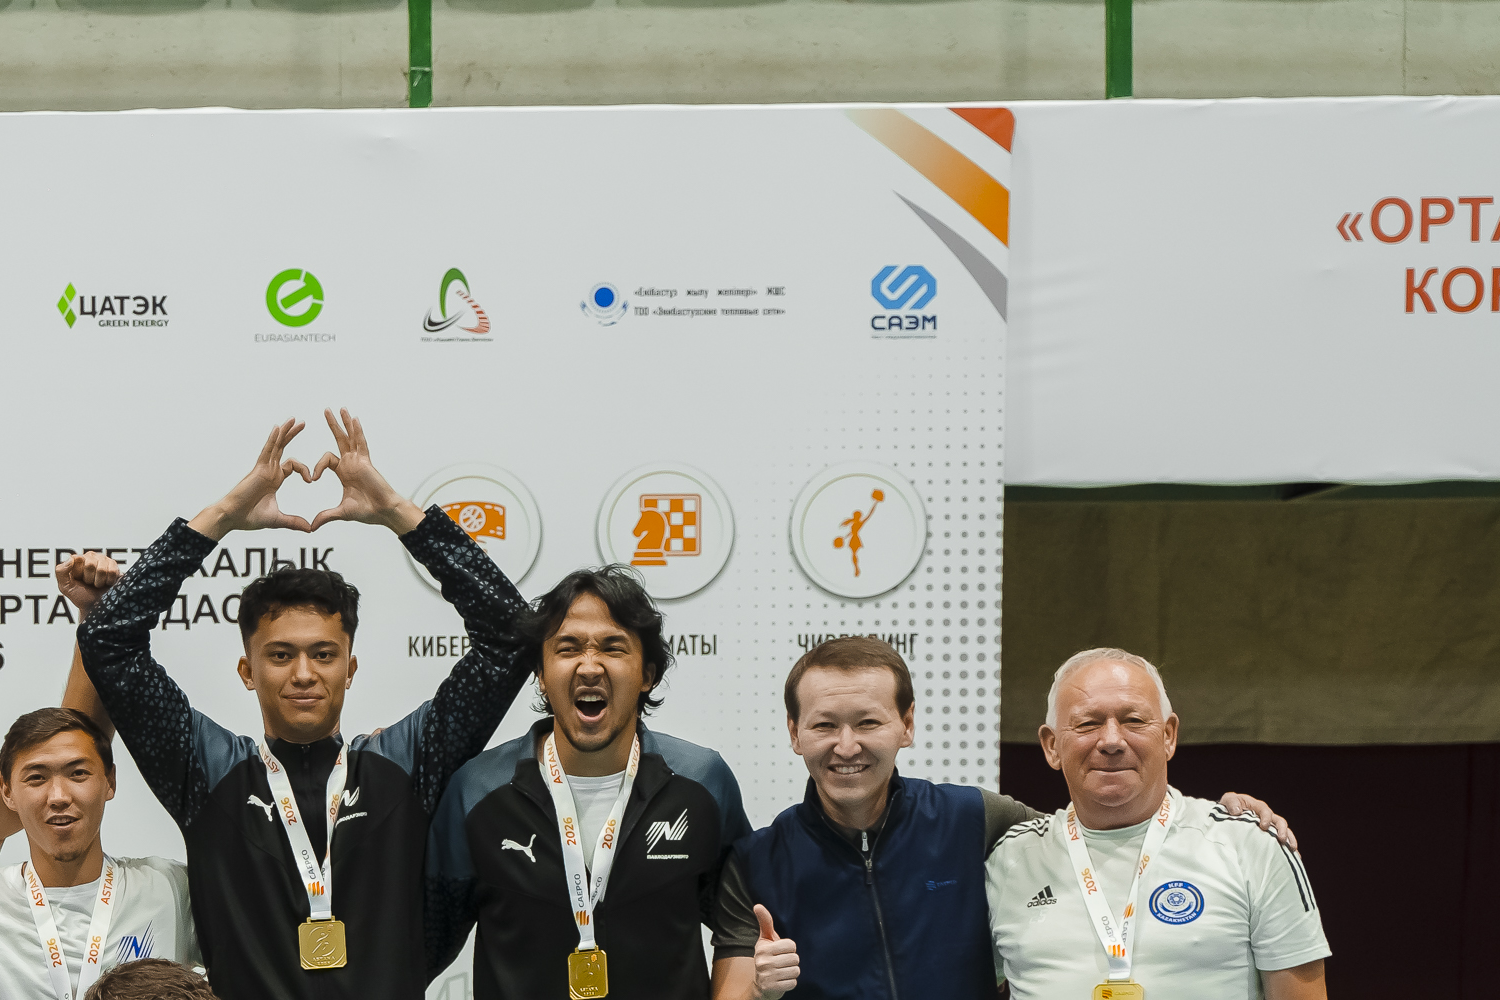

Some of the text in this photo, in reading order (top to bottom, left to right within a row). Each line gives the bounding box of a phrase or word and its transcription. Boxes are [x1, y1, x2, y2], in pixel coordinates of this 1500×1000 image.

[1336, 196, 1500, 244] «ОРТ
[1405, 266, 1500, 314] КО
[79, 295, 167, 318] ЦАТЭК
[98, 319, 169, 327] GREEN ENERGY
[871, 315, 937, 330] САЭМ
[254, 333, 336, 343] EURASIANTECH
[408, 635, 472, 657] КИБЕР
[281, 797, 297, 826] 2026
[562, 817, 577, 846] 2026
[601, 819, 617, 850] 2026
[301, 849, 317, 881] CAEPCO
[574, 873, 585, 908] CAEPCO
[1081, 867, 1098, 896] 2026
[1027, 897, 1057, 908] adidas
[47, 938, 63, 968] 2026
[87, 936, 101, 964] 2026
